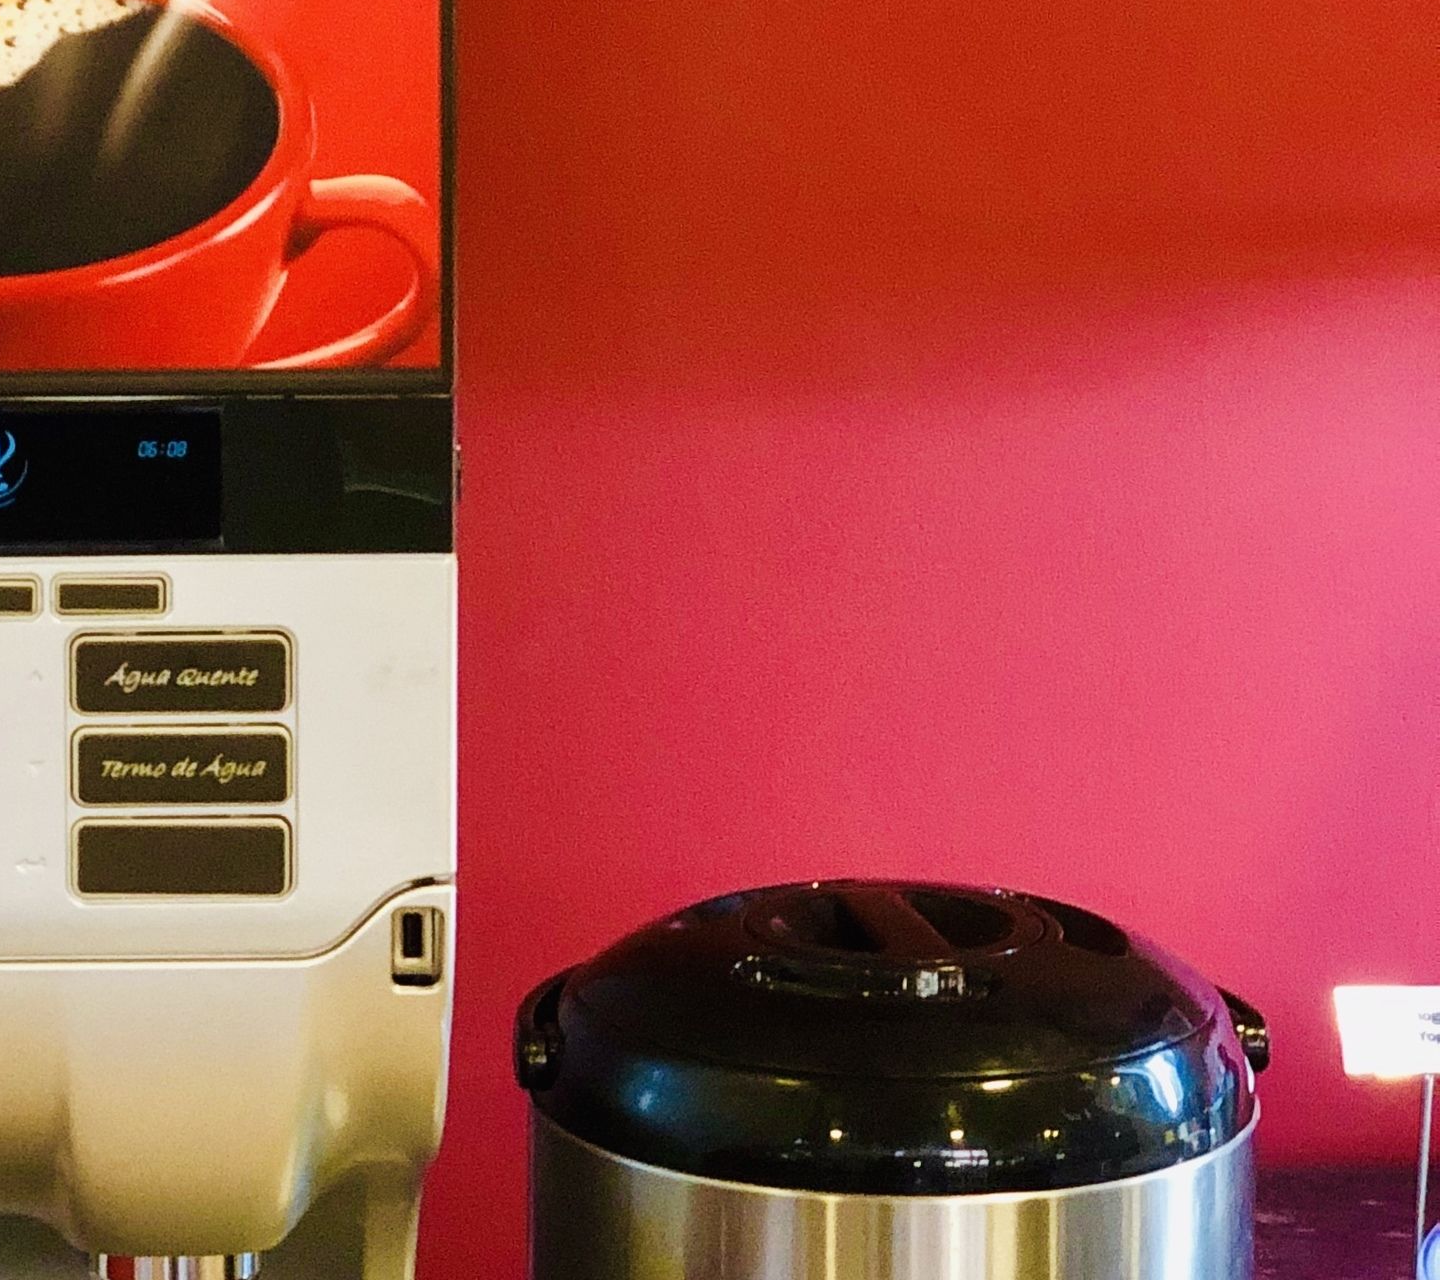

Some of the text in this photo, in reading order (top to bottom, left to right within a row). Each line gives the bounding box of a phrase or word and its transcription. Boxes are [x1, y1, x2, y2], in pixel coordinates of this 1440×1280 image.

[138, 440, 189, 458] 06:08
[104, 662, 259, 694] Água Quente
[101, 753, 266, 784] Termo de Água
